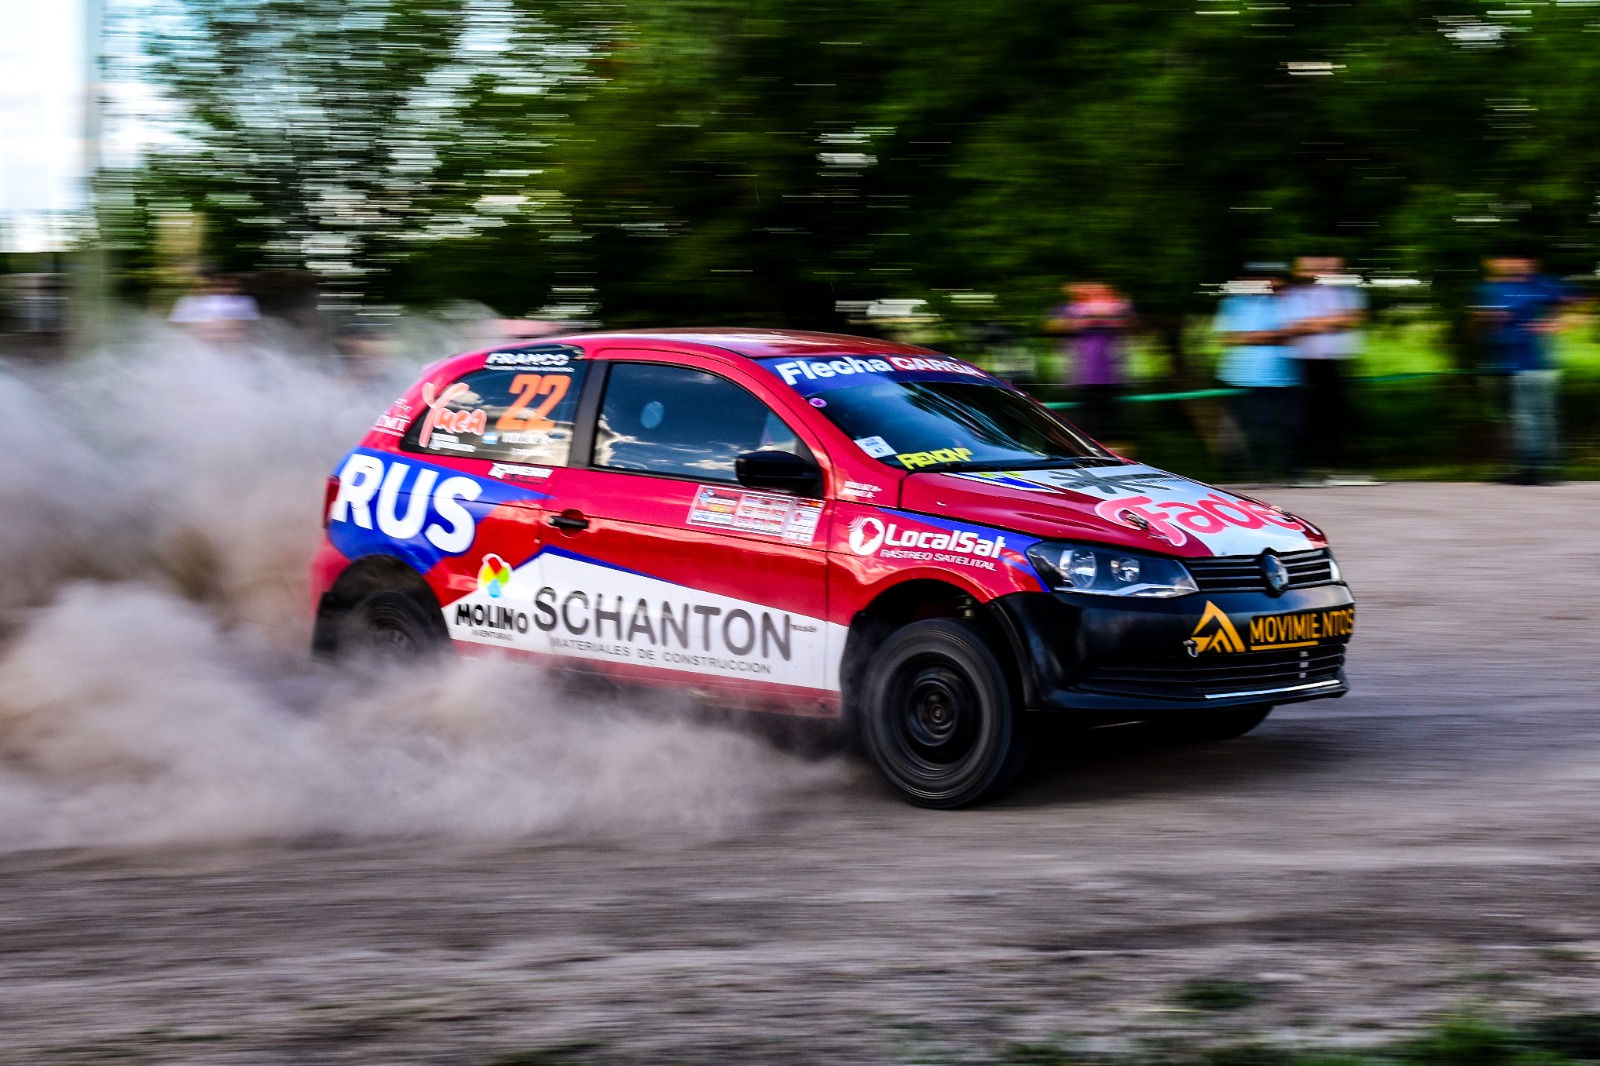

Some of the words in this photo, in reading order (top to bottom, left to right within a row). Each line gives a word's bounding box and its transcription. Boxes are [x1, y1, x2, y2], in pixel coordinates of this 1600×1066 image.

[775, 357, 895, 385] Flecha
[496, 374, 571, 430] 22
[331, 453, 483, 553] RUS
[884, 523, 1006, 559] LocalSat
[880, 548, 932, 561] RASTREO
[934, 551, 997, 572] SATELITAL
[456, 603, 530, 635] MOLINO
[534, 586, 791, 662] SCHANTON
[551, 636, 632, 657] MATERIALES
[637, 648, 656, 661] DE
[663, 651, 772, 675] CONSTRUCCION
